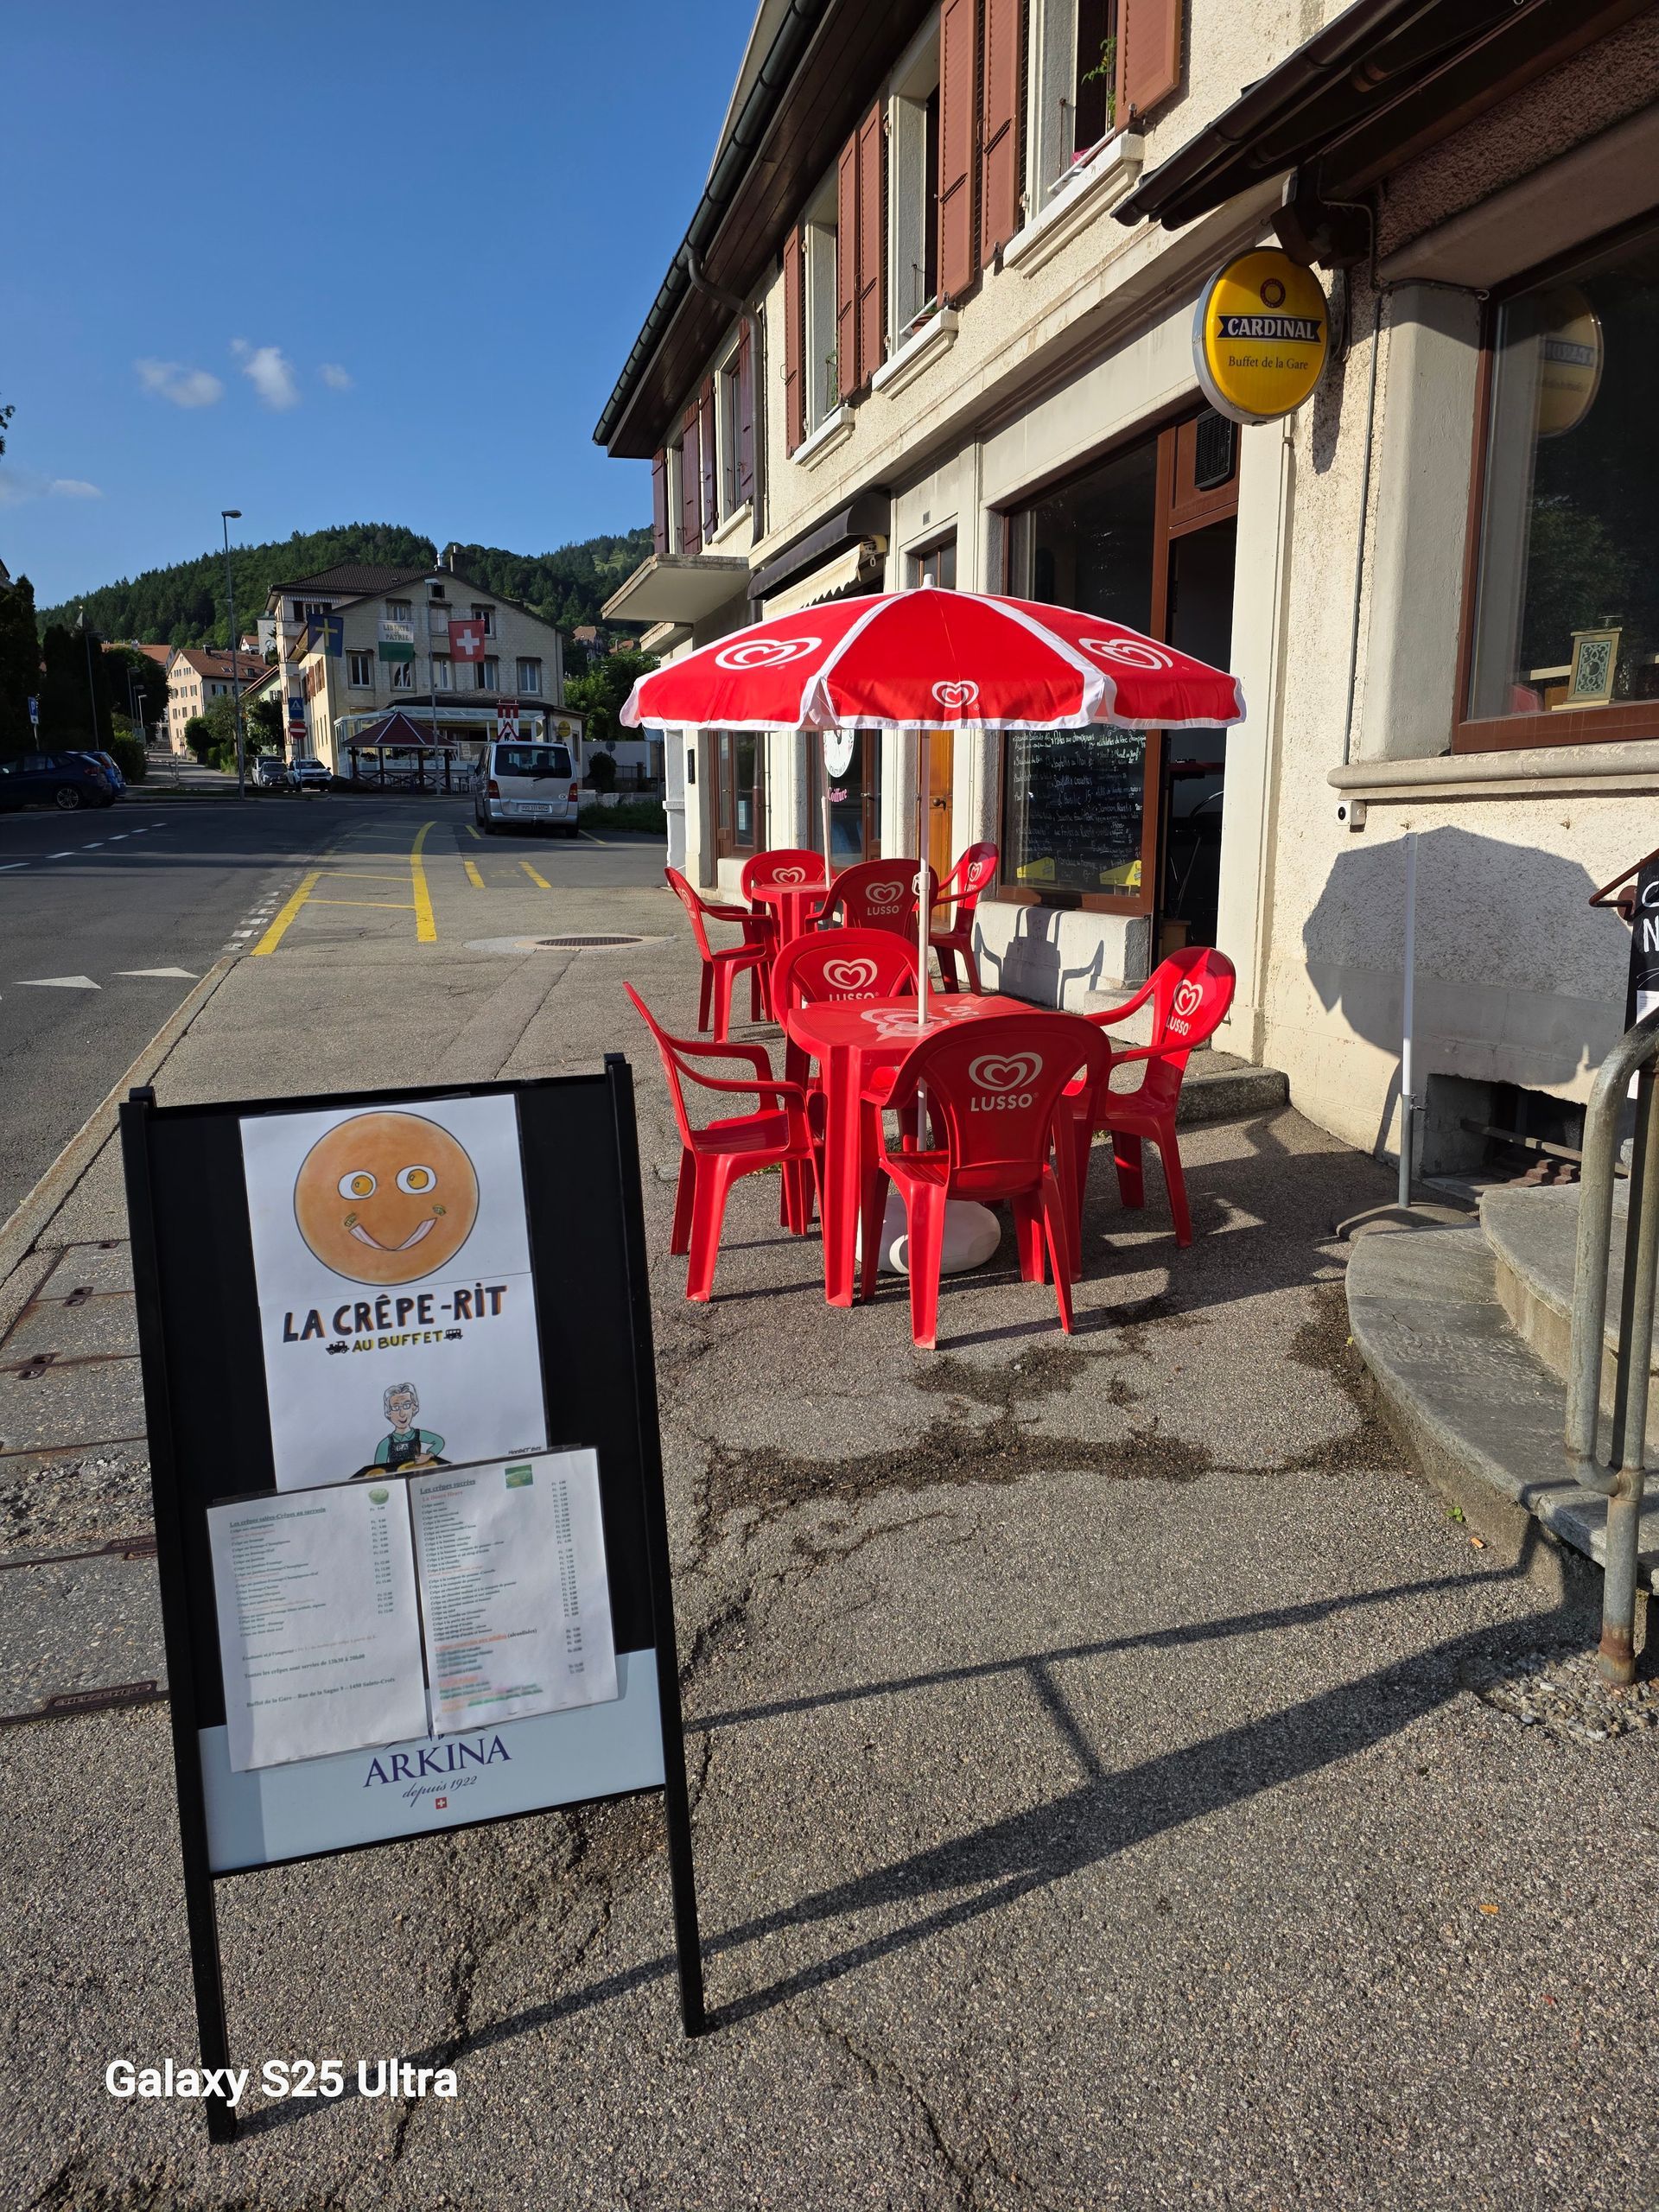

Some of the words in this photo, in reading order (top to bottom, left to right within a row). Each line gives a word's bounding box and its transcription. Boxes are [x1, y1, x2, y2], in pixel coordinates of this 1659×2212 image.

[1227, 317, 1314, 340] CARDINAL
[1229, 355, 1259, 367] Buffet
[1262, 356, 1272, 368] de
[1275, 357, 1284, 369] la
[1286, 358, 1308, 370] Gare
[828, 787, 847, 802] Coiffure
[867, 905, 899, 916] LUSSO
[1166, 1014, 1189, 1036] LUSSO
[970, 1093, 1033, 1112] LUSSO
[283, 1309, 326, 1343] LA
[352, 1338, 372, 1353] AU
[378, 1330, 442, 1350] BUFFET
[432, 1482, 451, 1492] crêpes
[363, 1735, 512, 1788] ARKINA
[402, 1781, 448, 1808] depuis
[449, 1776, 477, 1791] 1922
